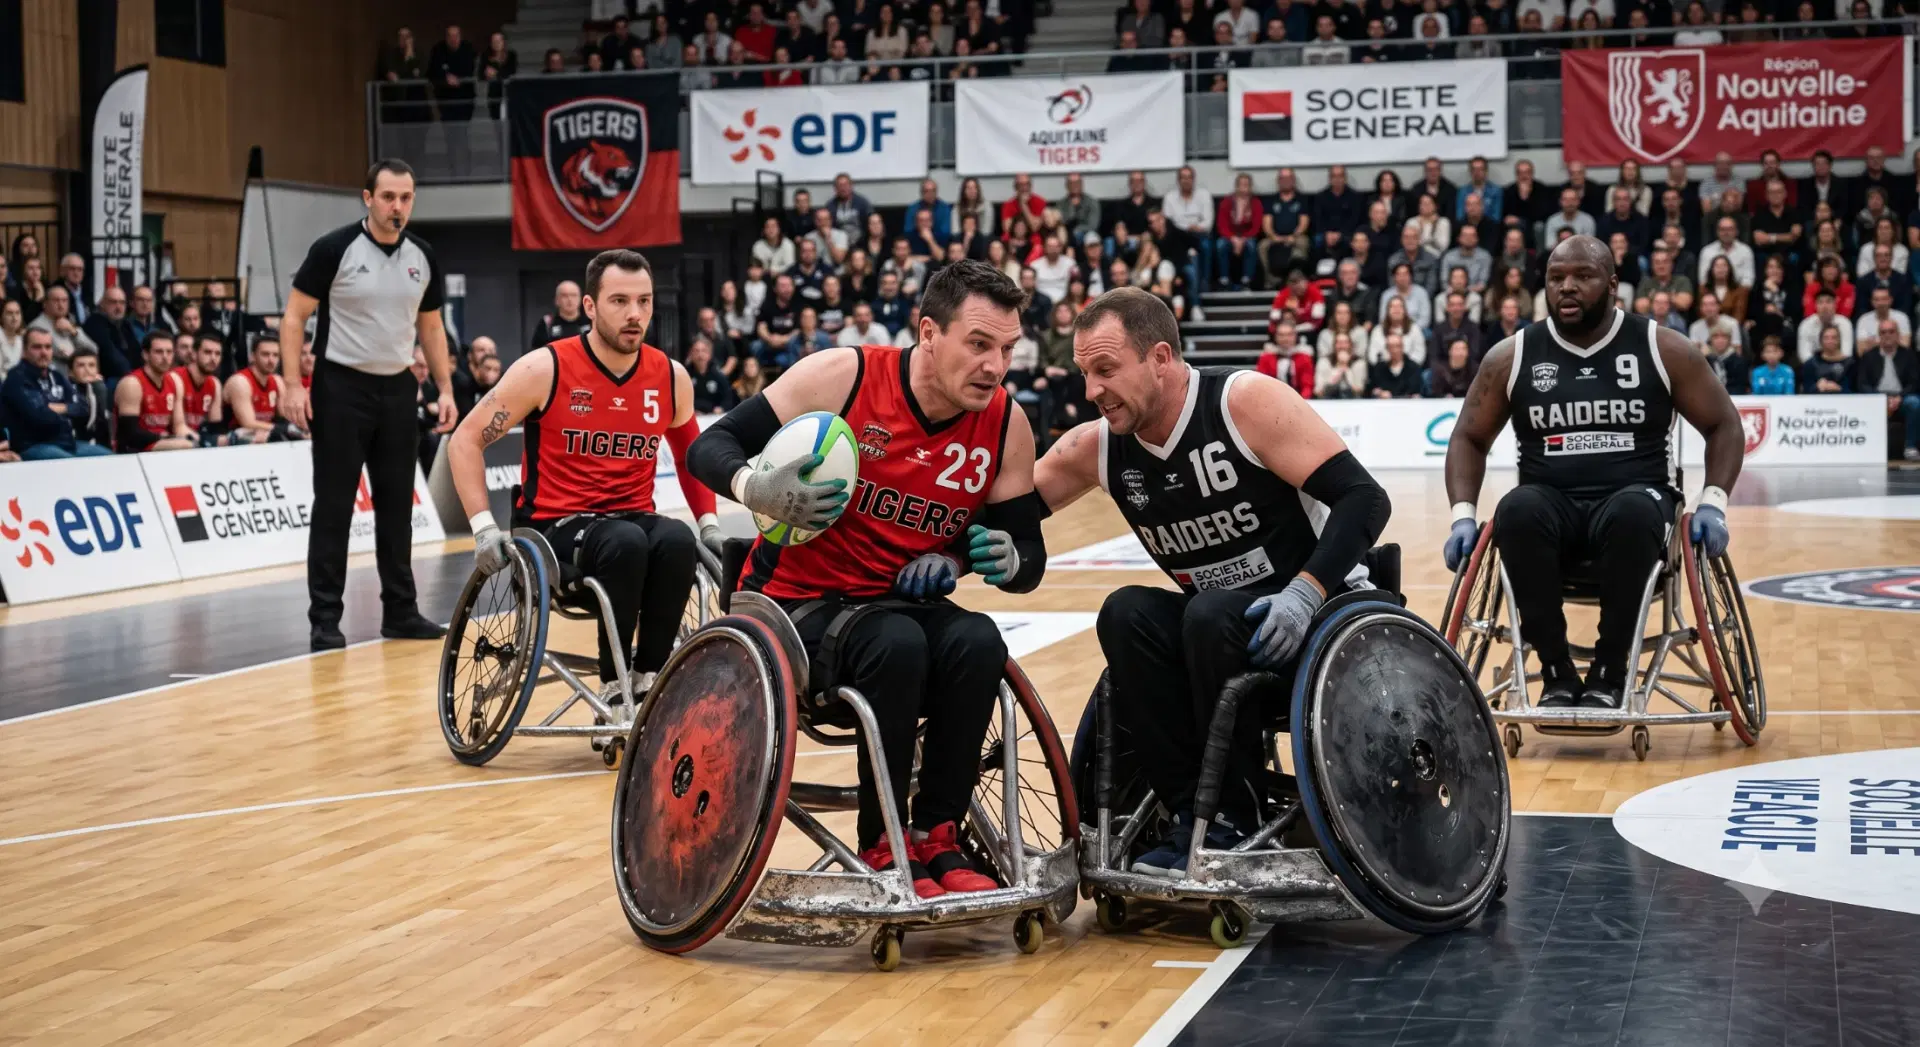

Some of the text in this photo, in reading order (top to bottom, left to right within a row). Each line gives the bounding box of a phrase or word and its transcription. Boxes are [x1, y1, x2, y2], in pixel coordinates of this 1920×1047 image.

[1764, 57, 1820, 74] Région
[1306, 84, 1457, 112] SOCIETE
[1716, 69, 1868, 100] Nouvelle-
[553, 110, 638, 143] TIGERS
[1306, 111, 1495, 141] GENERALE
[1716, 99, 1867, 136] Aquitaine
[1028, 128, 1108, 146] AQUITAINE
[1037, 145, 1101, 165] TIGERS
[1615, 353, 1640, 389] 9
[643, 389, 660, 424] 5
[1528, 399, 1646, 429] RAIDERS
[562, 428, 660, 460] TIGERS
[1566, 433, 1618, 443] SOCIETE
[1566, 440, 1631, 451] GENERALE
[1778, 433, 1867, 451] Aquitaine
[935, 442, 991, 494] 23
[1188, 440, 1239, 498] 16
[212, 504, 311, 538] GÉNÉRALE
[1138, 501, 1260, 556] RAIDERS
[1194, 557, 1251, 582] SOCIETE
[1200, 562, 1269, 591] GENERALE
